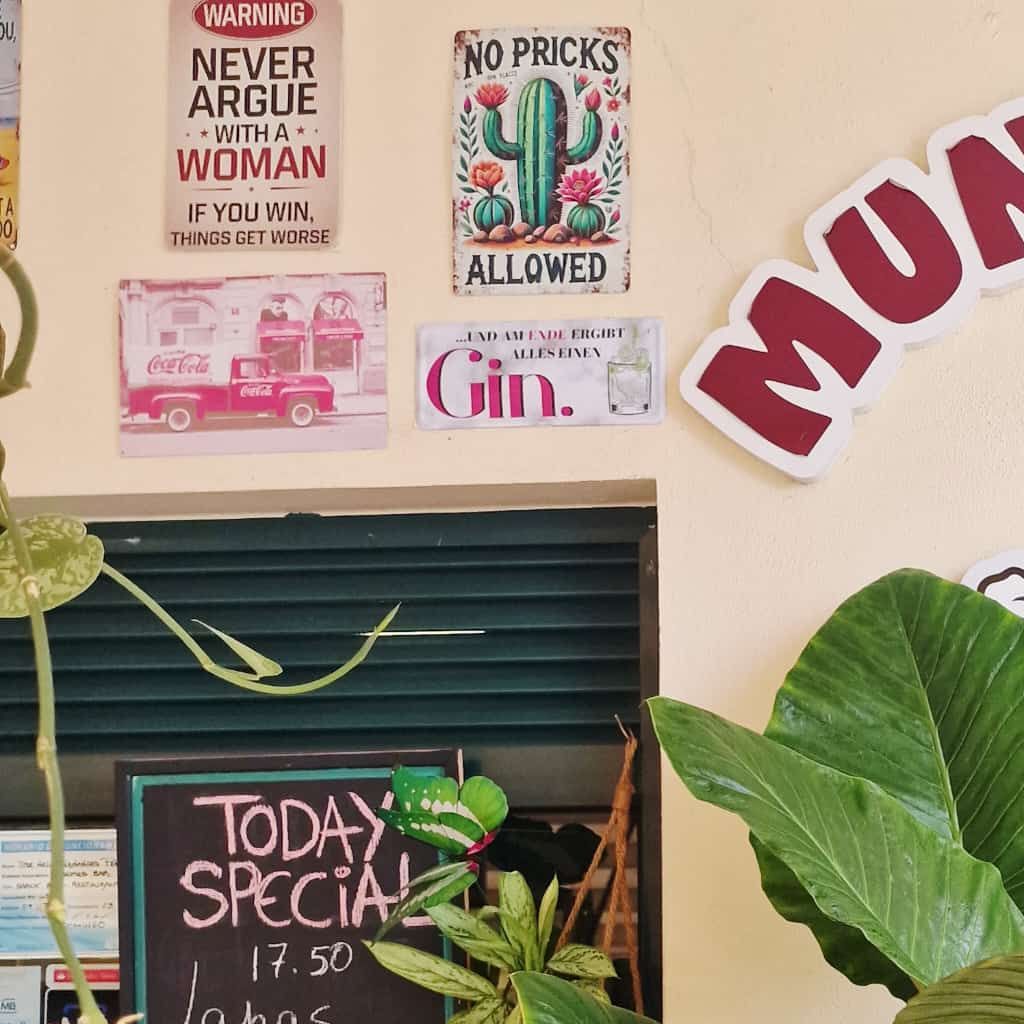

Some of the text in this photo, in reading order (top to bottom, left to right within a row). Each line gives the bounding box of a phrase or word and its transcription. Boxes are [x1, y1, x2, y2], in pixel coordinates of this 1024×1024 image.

[203, 2, 306, 27] WARNING
[0, 21, 17, 43] OU,
[192, 46, 315, 81] NEVER
[463, 39, 504, 80] NO
[512, 36, 621, 75] PRICKS
[187, 82, 318, 118] ARGUE
[215, 122, 289, 143] WITH A
[177, 145, 326, 181] WOMAN
[188, 201, 314, 224] IF YOU WIN,
[171, 229, 330, 246] THINGS GET WORSE
[465, 252, 607, 286] ALLOWED
[503, 331, 524, 341] AM
[528, 329, 566, 341] ENDE
[571, 327, 626, 340] ERGIBT
[512, 347, 601, 360] ALLES EINEN
[426, 347, 574, 419] Gin.
[193, 790, 395, 863] TODAY
[251, 942, 353, 982] 17.50
